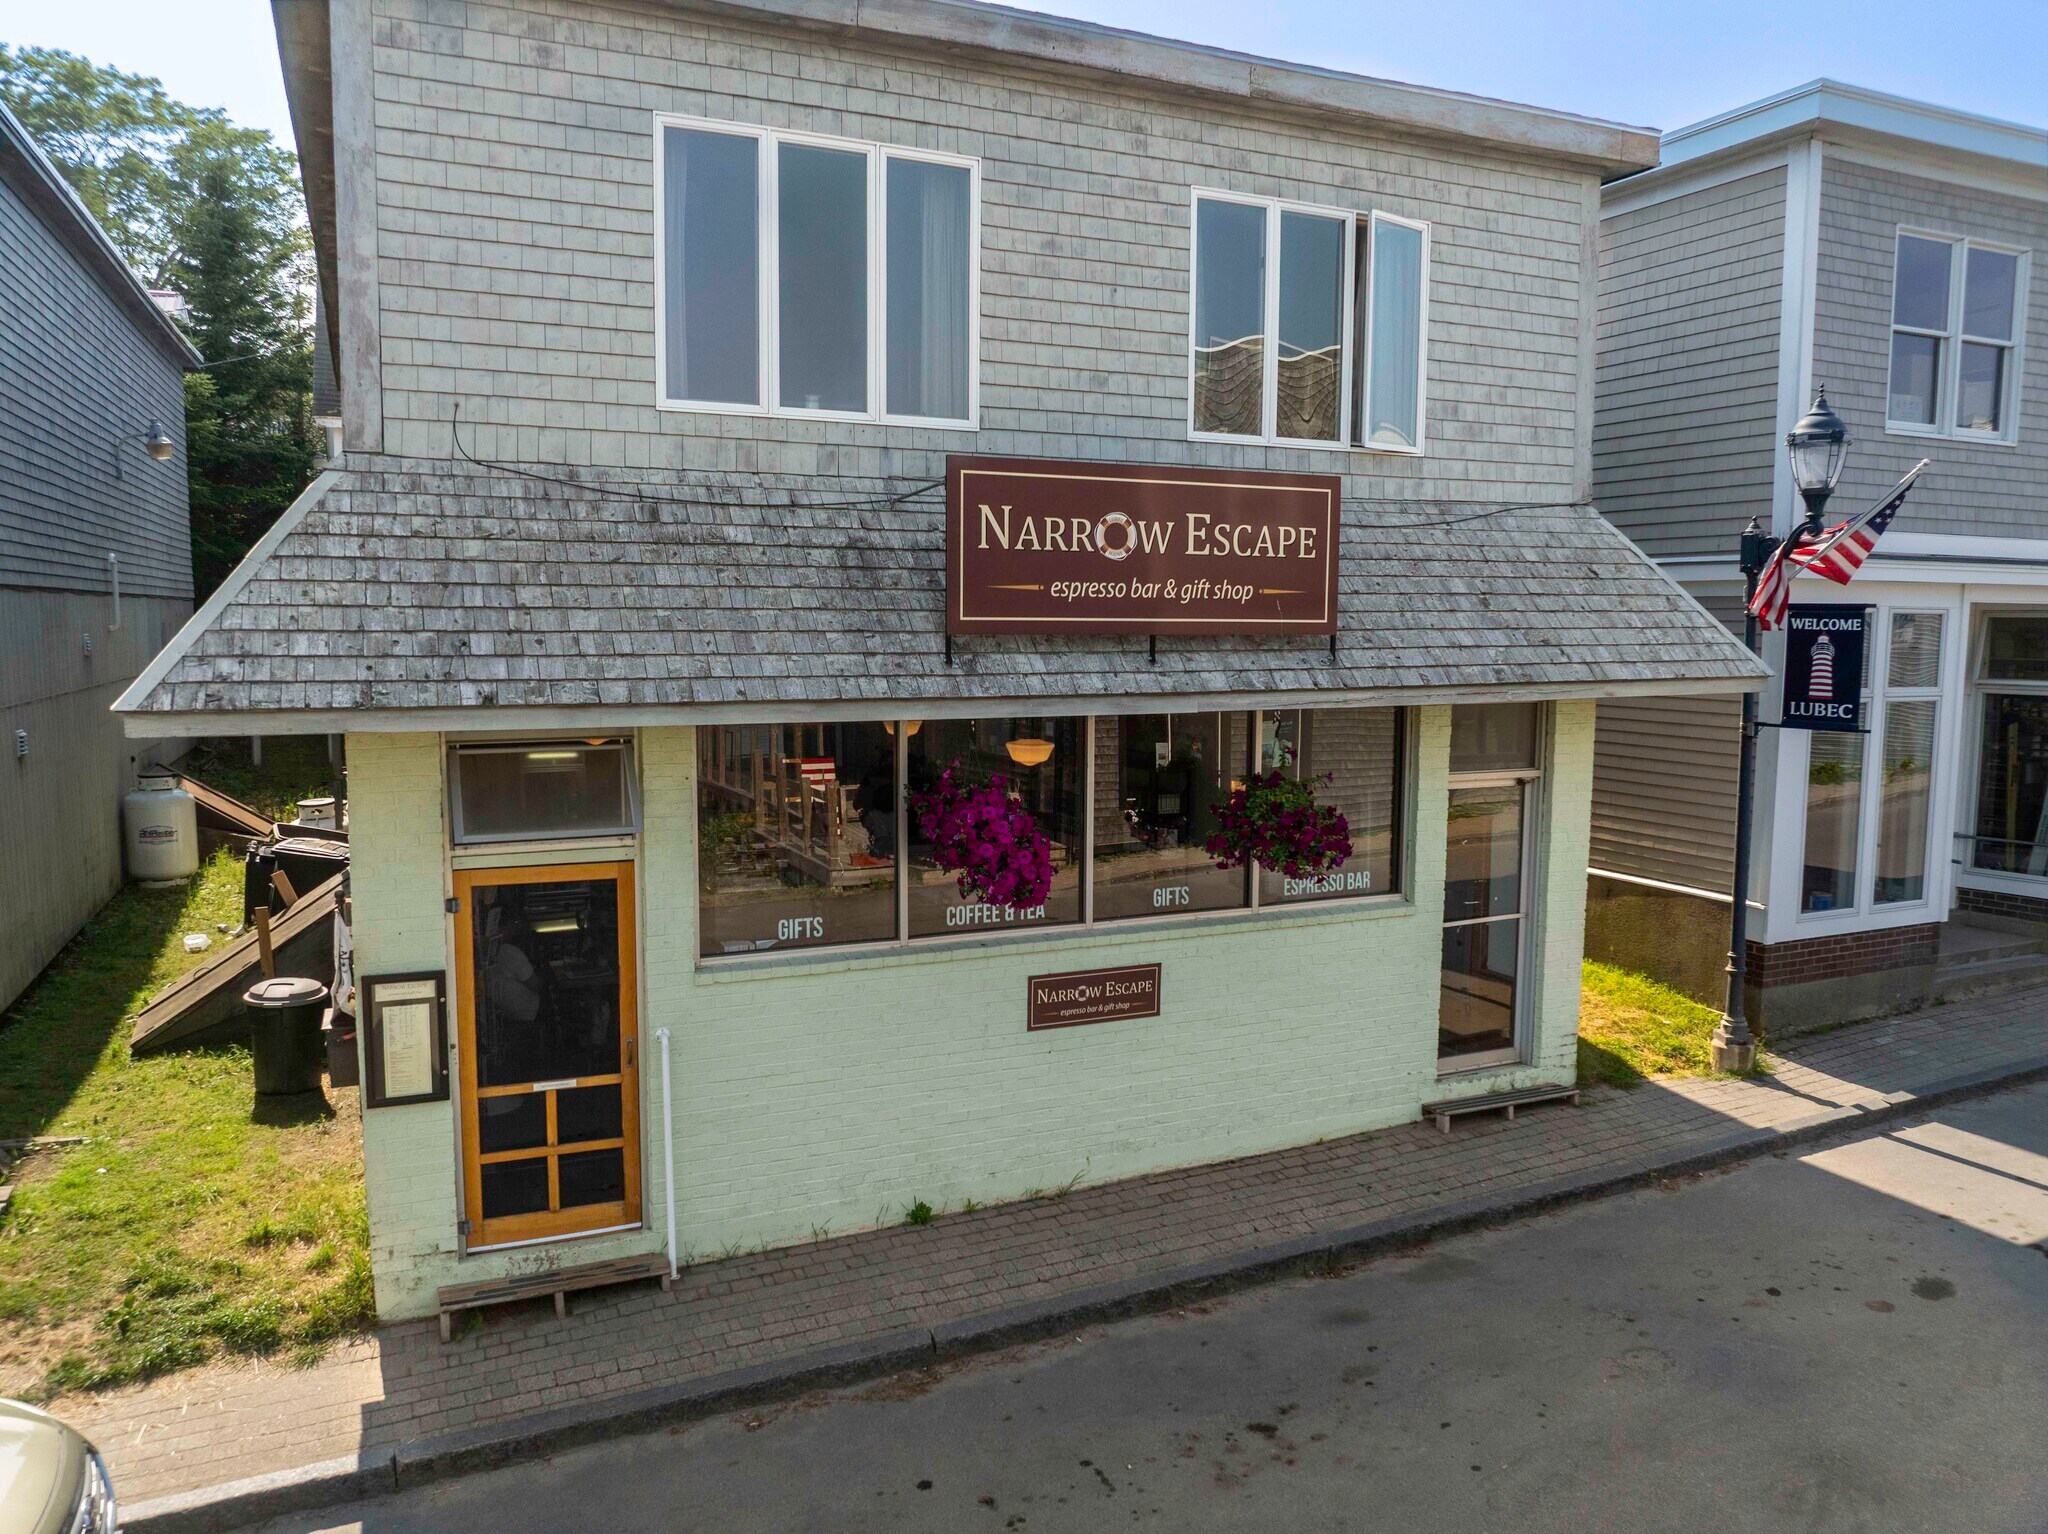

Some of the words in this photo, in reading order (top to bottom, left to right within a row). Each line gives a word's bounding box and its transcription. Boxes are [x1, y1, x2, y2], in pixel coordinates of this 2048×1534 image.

[978, 504, 1175, 561] NARROW
[1186, 512, 1317, 559] ESCAPE
[1051, 581, 1126, 602] espresso
[1131, 577, 1161, 599] bar
[1164, 579, 1177, 599] &
[1180, 579, 1211, 604] gift
[1213, 580, 1254, 604] shop
[1791, 618, 1861, 631] WELCOME
[1790, 701, 1853, 719] LUBEC
[1347, 871, 1370, 890] BAR
[1153, 886, 1190, 907] GIFTS
[946, 904, 1000, 926] COFFEE
[1005, 902, 1014, 921] &
[778, 916, 823, 940] GIFTS
[1037, 985, 1102, 1004] NARROW
[1106, 981, 1153, 996] ESCAPE
[1060, 1006, 1086, 1017] espresso
[1087, 1005, 1097, 1013] bar
[1098, 1004, 1103, 1012] &
[1104, 1002, 1115, 1012] gift
[1115, 1002, 1130, 1010] shop
